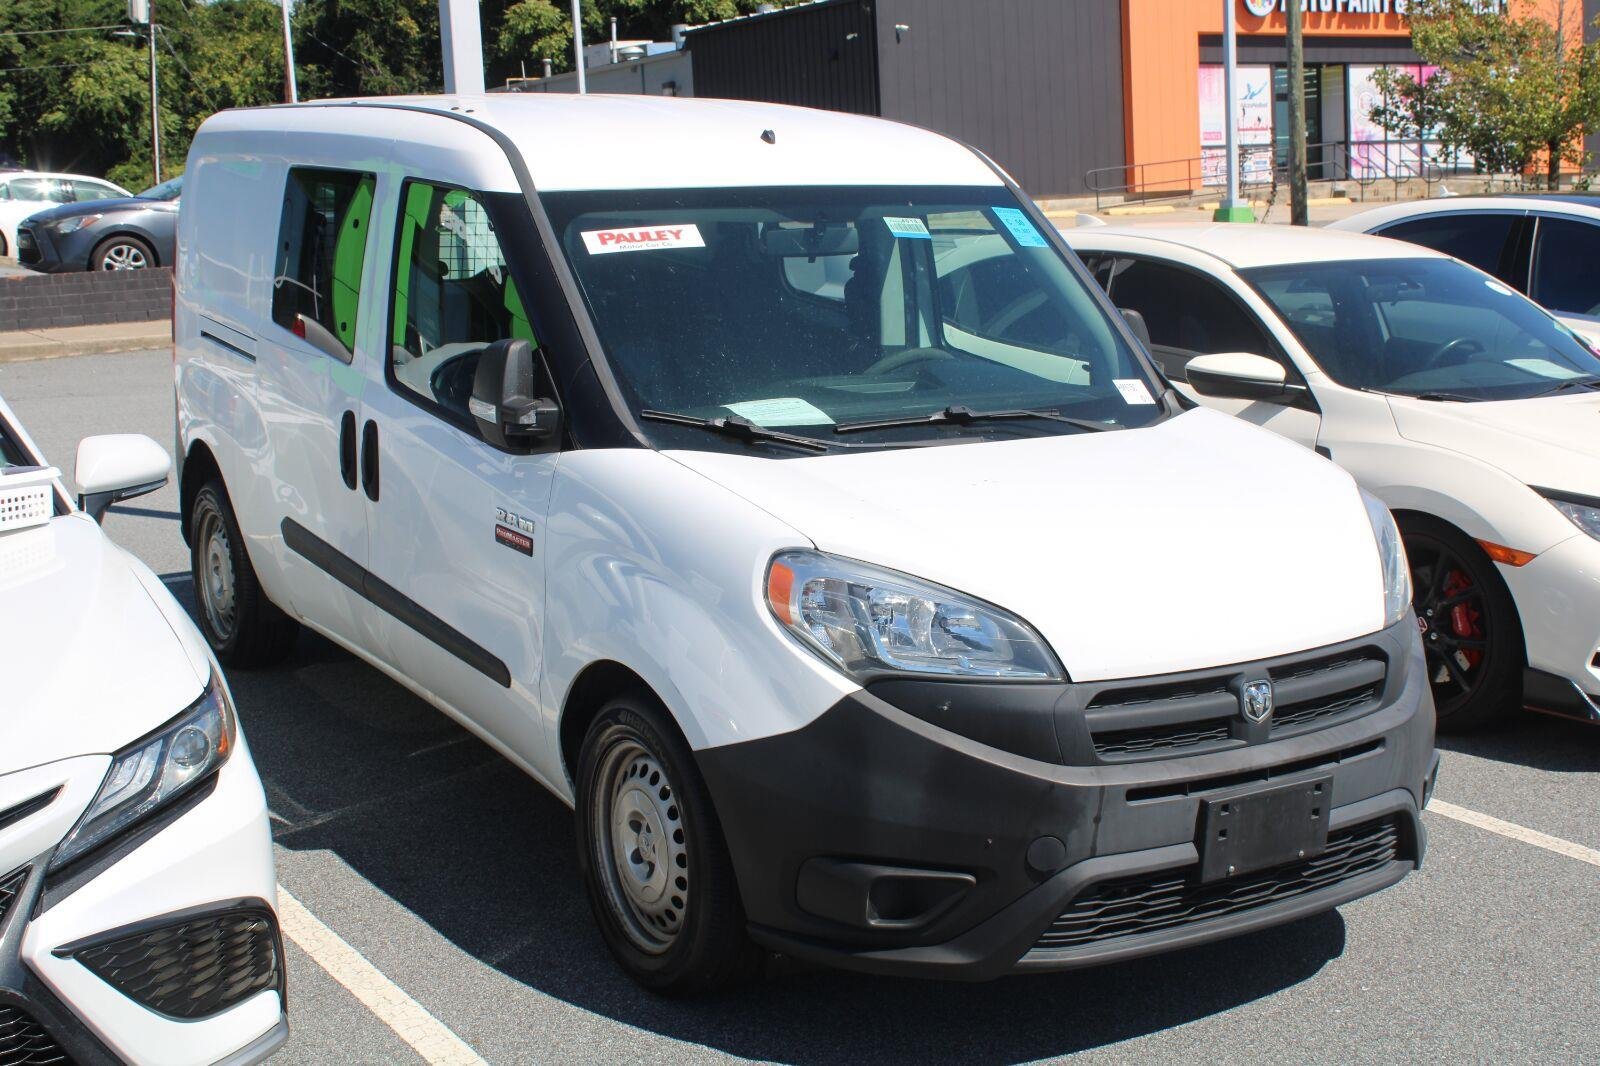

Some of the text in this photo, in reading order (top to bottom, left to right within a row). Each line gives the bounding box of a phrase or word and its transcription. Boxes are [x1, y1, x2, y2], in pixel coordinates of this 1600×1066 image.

[597, 229, 683, 246] PAULEY
[620, 243, 643, 251] Motor
[495, 506, 535, 534] RAM
